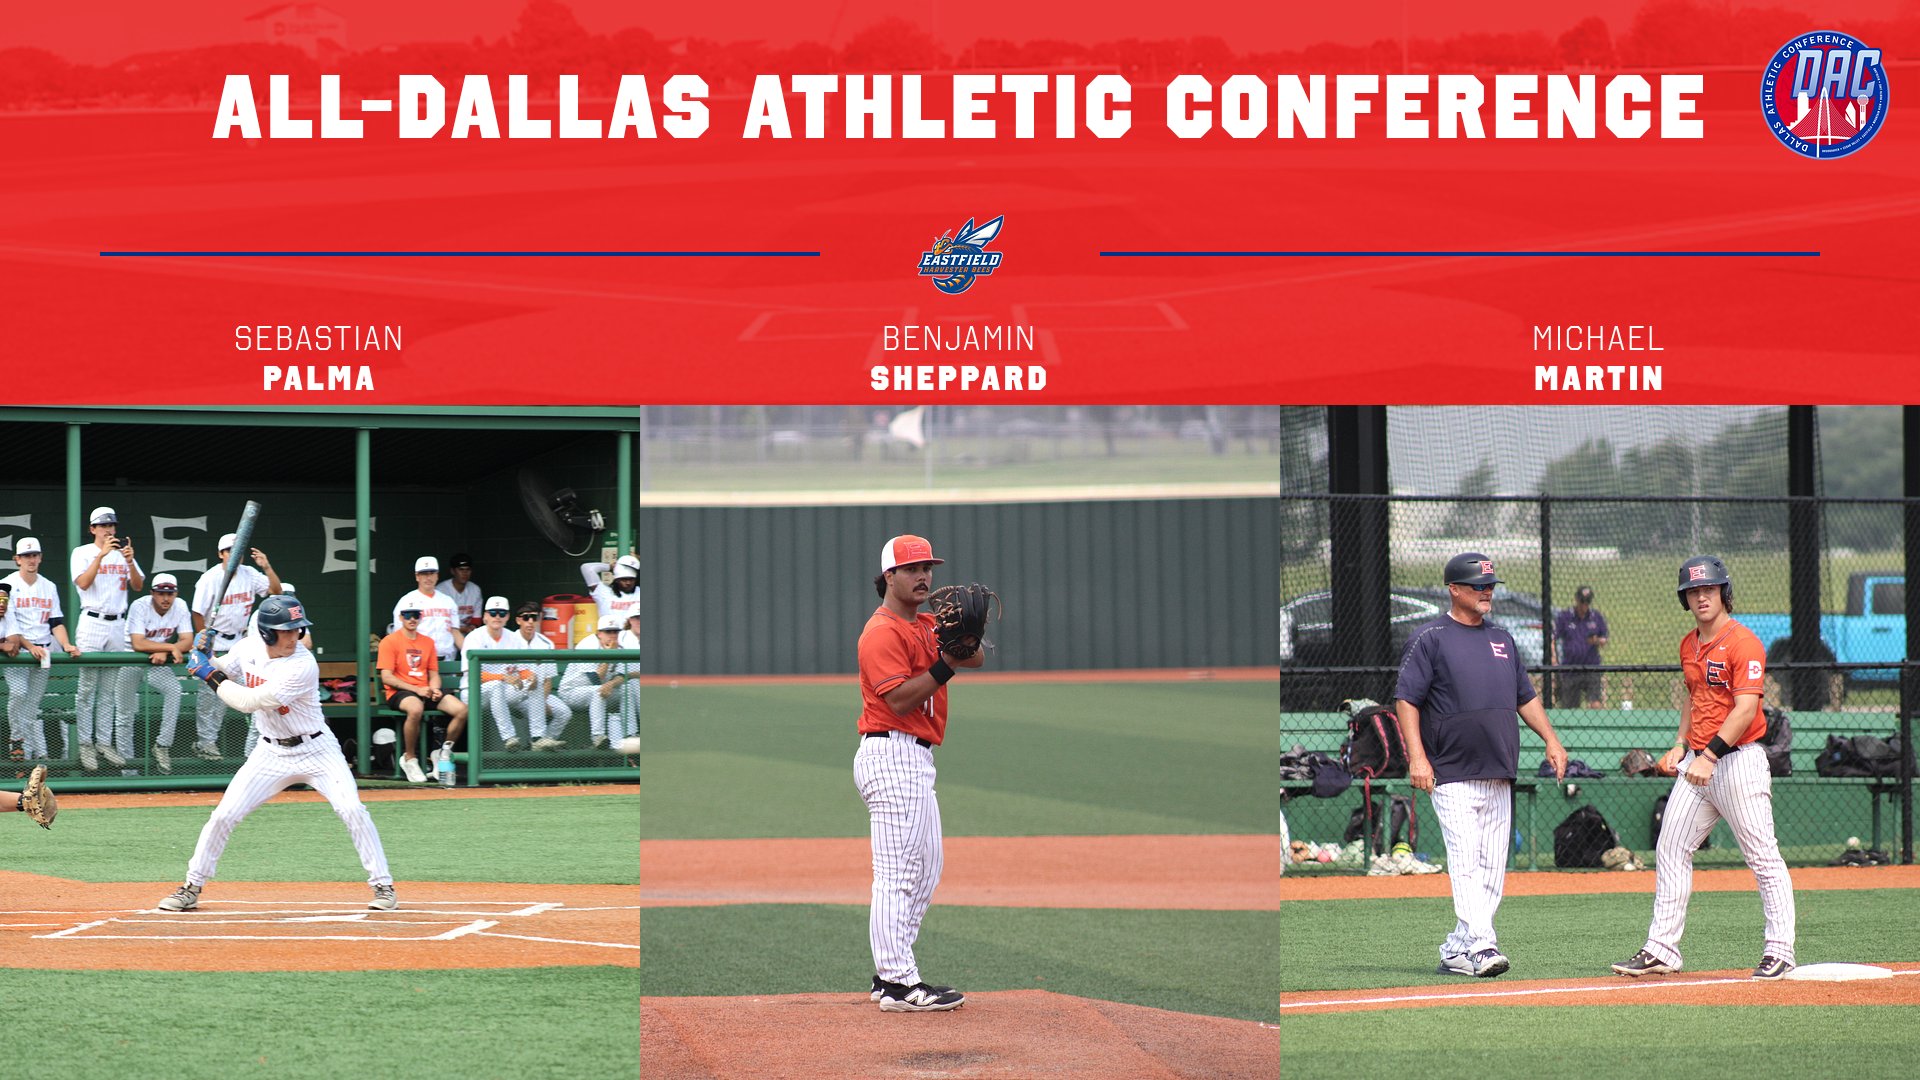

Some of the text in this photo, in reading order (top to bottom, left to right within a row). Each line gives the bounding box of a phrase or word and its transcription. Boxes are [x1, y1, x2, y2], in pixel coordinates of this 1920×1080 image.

[151, 516, 207, 574] E
[322, 516, 376, 573] E
[1490, 642, 1508, 659] E
[1706, 659, 1729, 688] E
